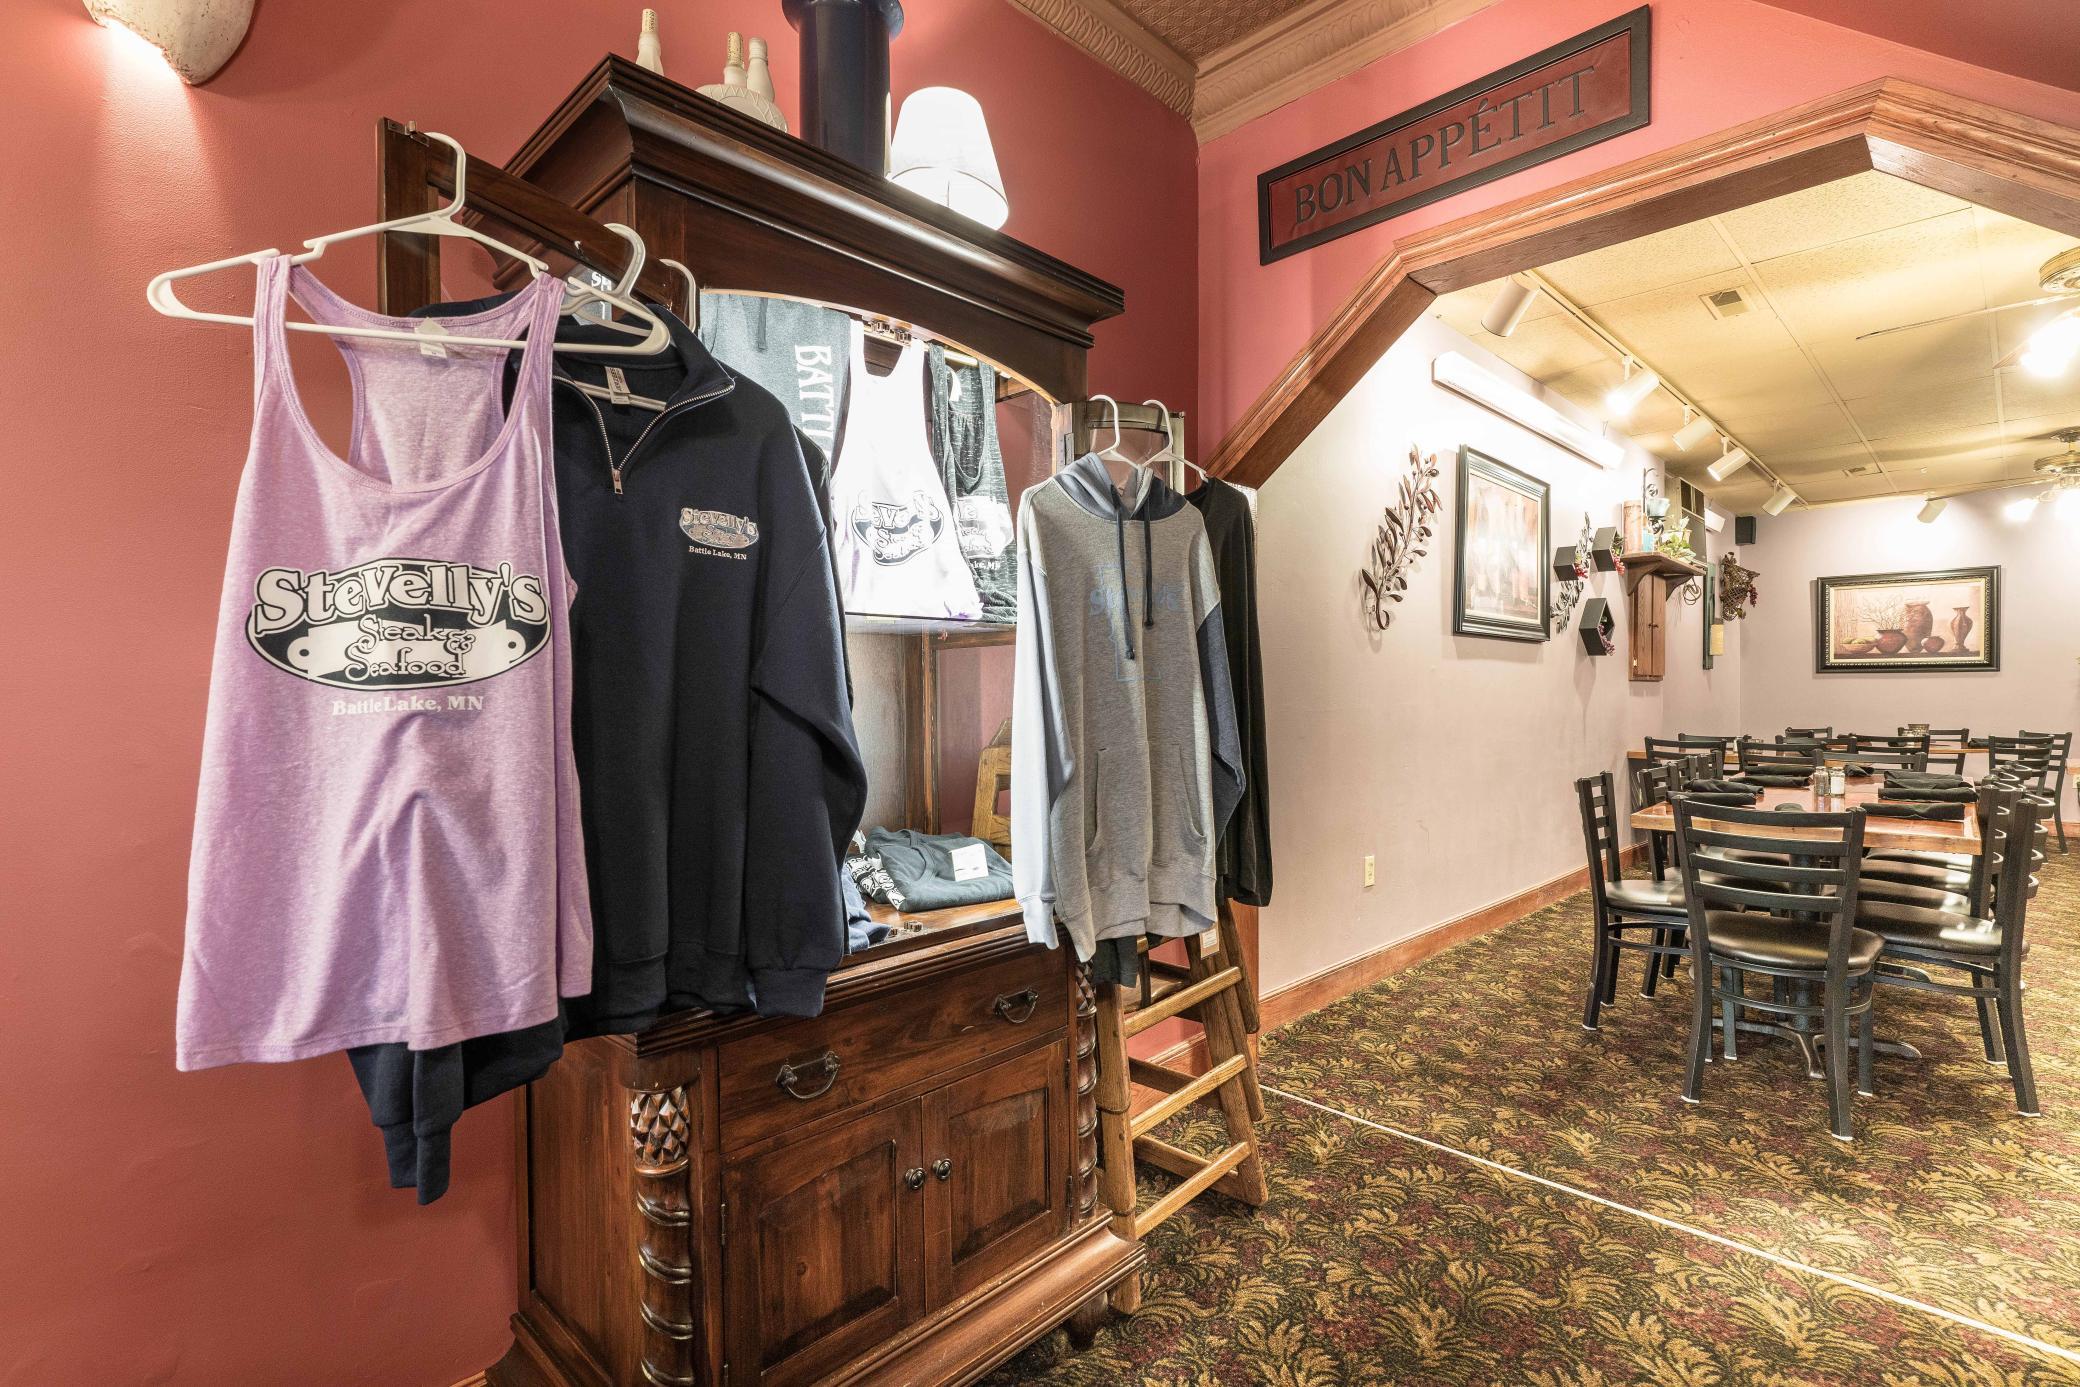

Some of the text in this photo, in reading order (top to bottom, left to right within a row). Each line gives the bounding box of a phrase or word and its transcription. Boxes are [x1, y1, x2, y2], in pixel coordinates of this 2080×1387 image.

[1295, 65, 1595, 224] BON APPÉTIT
[688, 545, 712, 555] Battle
[712, 549, 732, 558] Lake,
[358, 613, 476, 655] Steak &
[345, 642, 466, 681] Seafood
[331, 695, 484, 716] Battle Lake, MN
